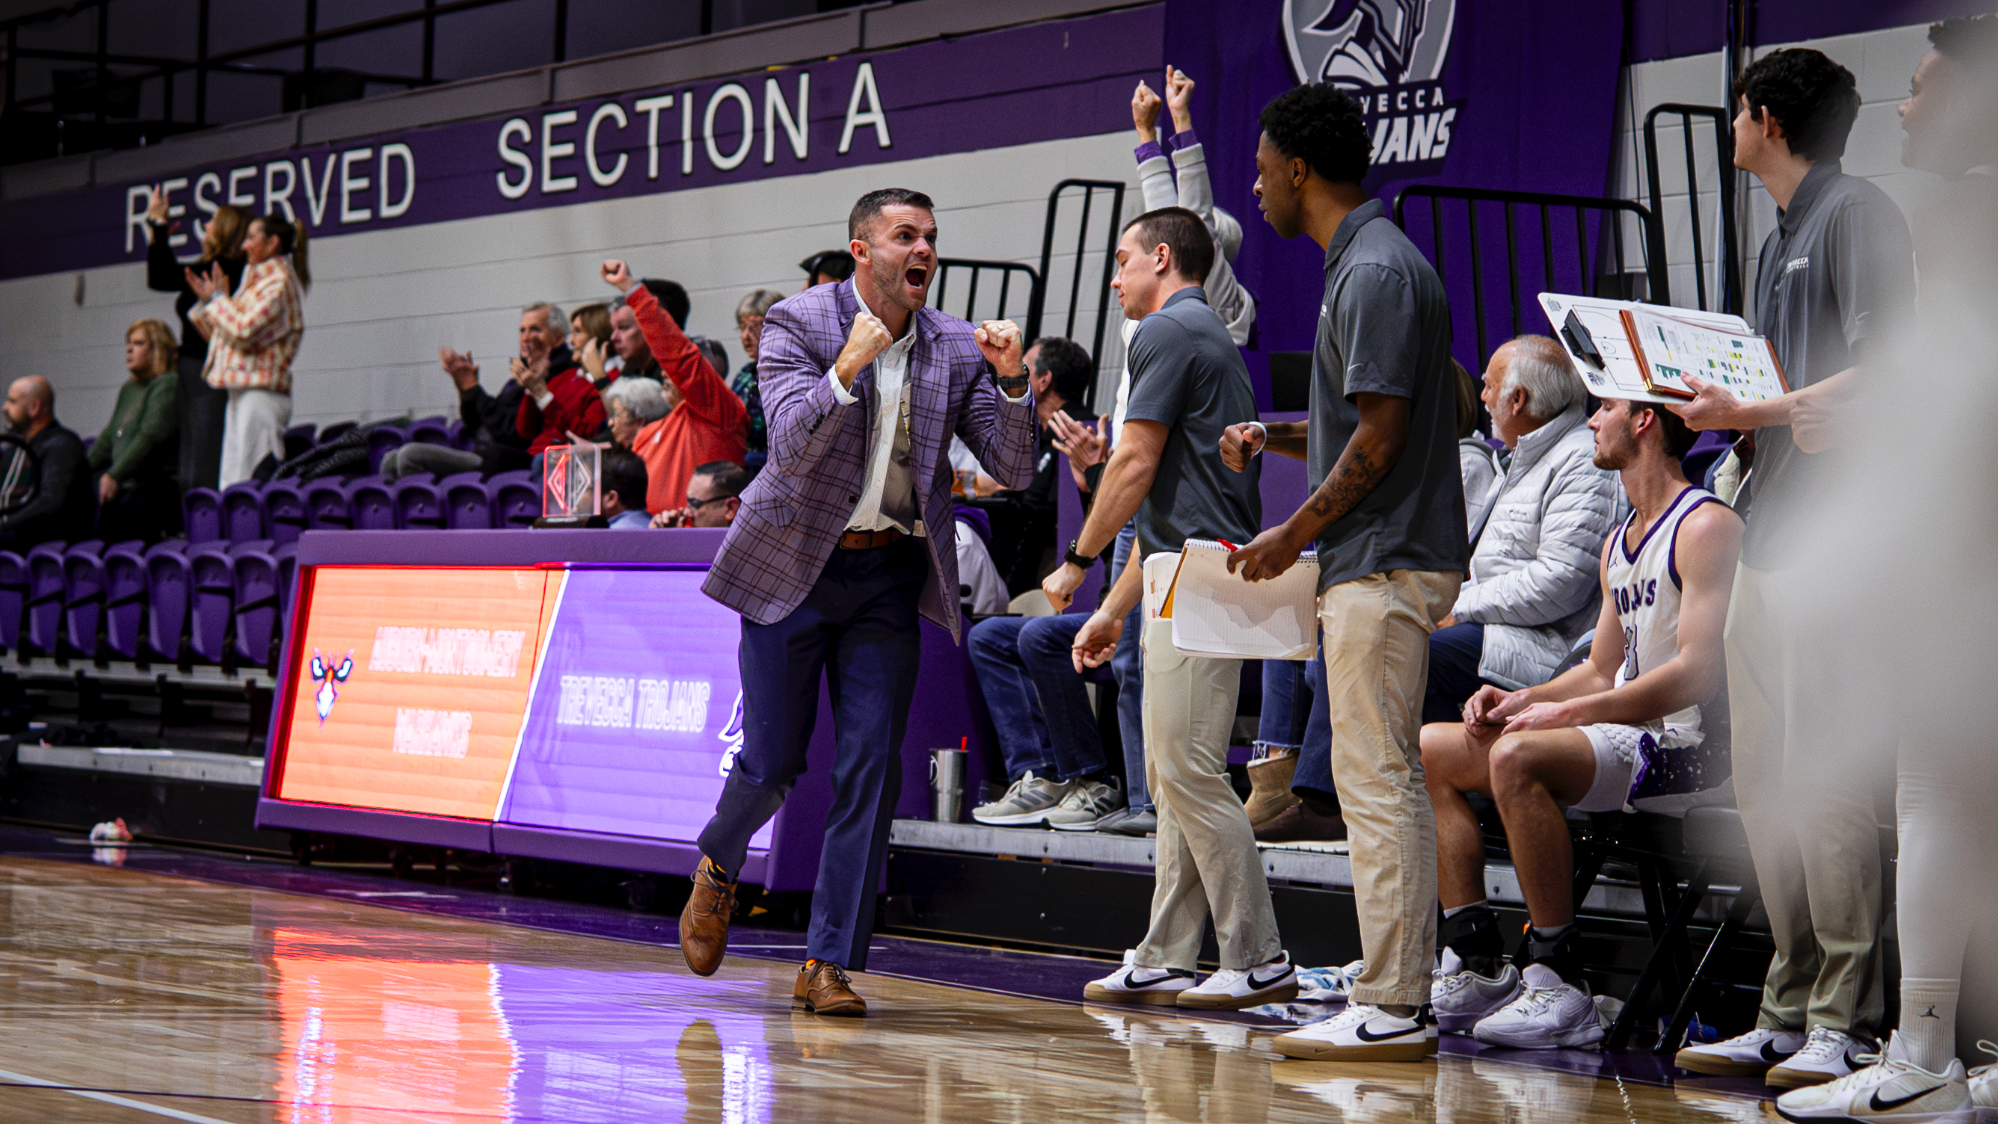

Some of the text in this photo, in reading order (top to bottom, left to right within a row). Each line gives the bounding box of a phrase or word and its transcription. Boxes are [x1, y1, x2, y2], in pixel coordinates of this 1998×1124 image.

[1360, 86, 1444, 115] VECCA
[125, 62, 891, 264] RESERVED SECTION A
[1369, 107, 1456, 165] JANS
[557, 675, 711, 733] TREVECCA TROJANS
